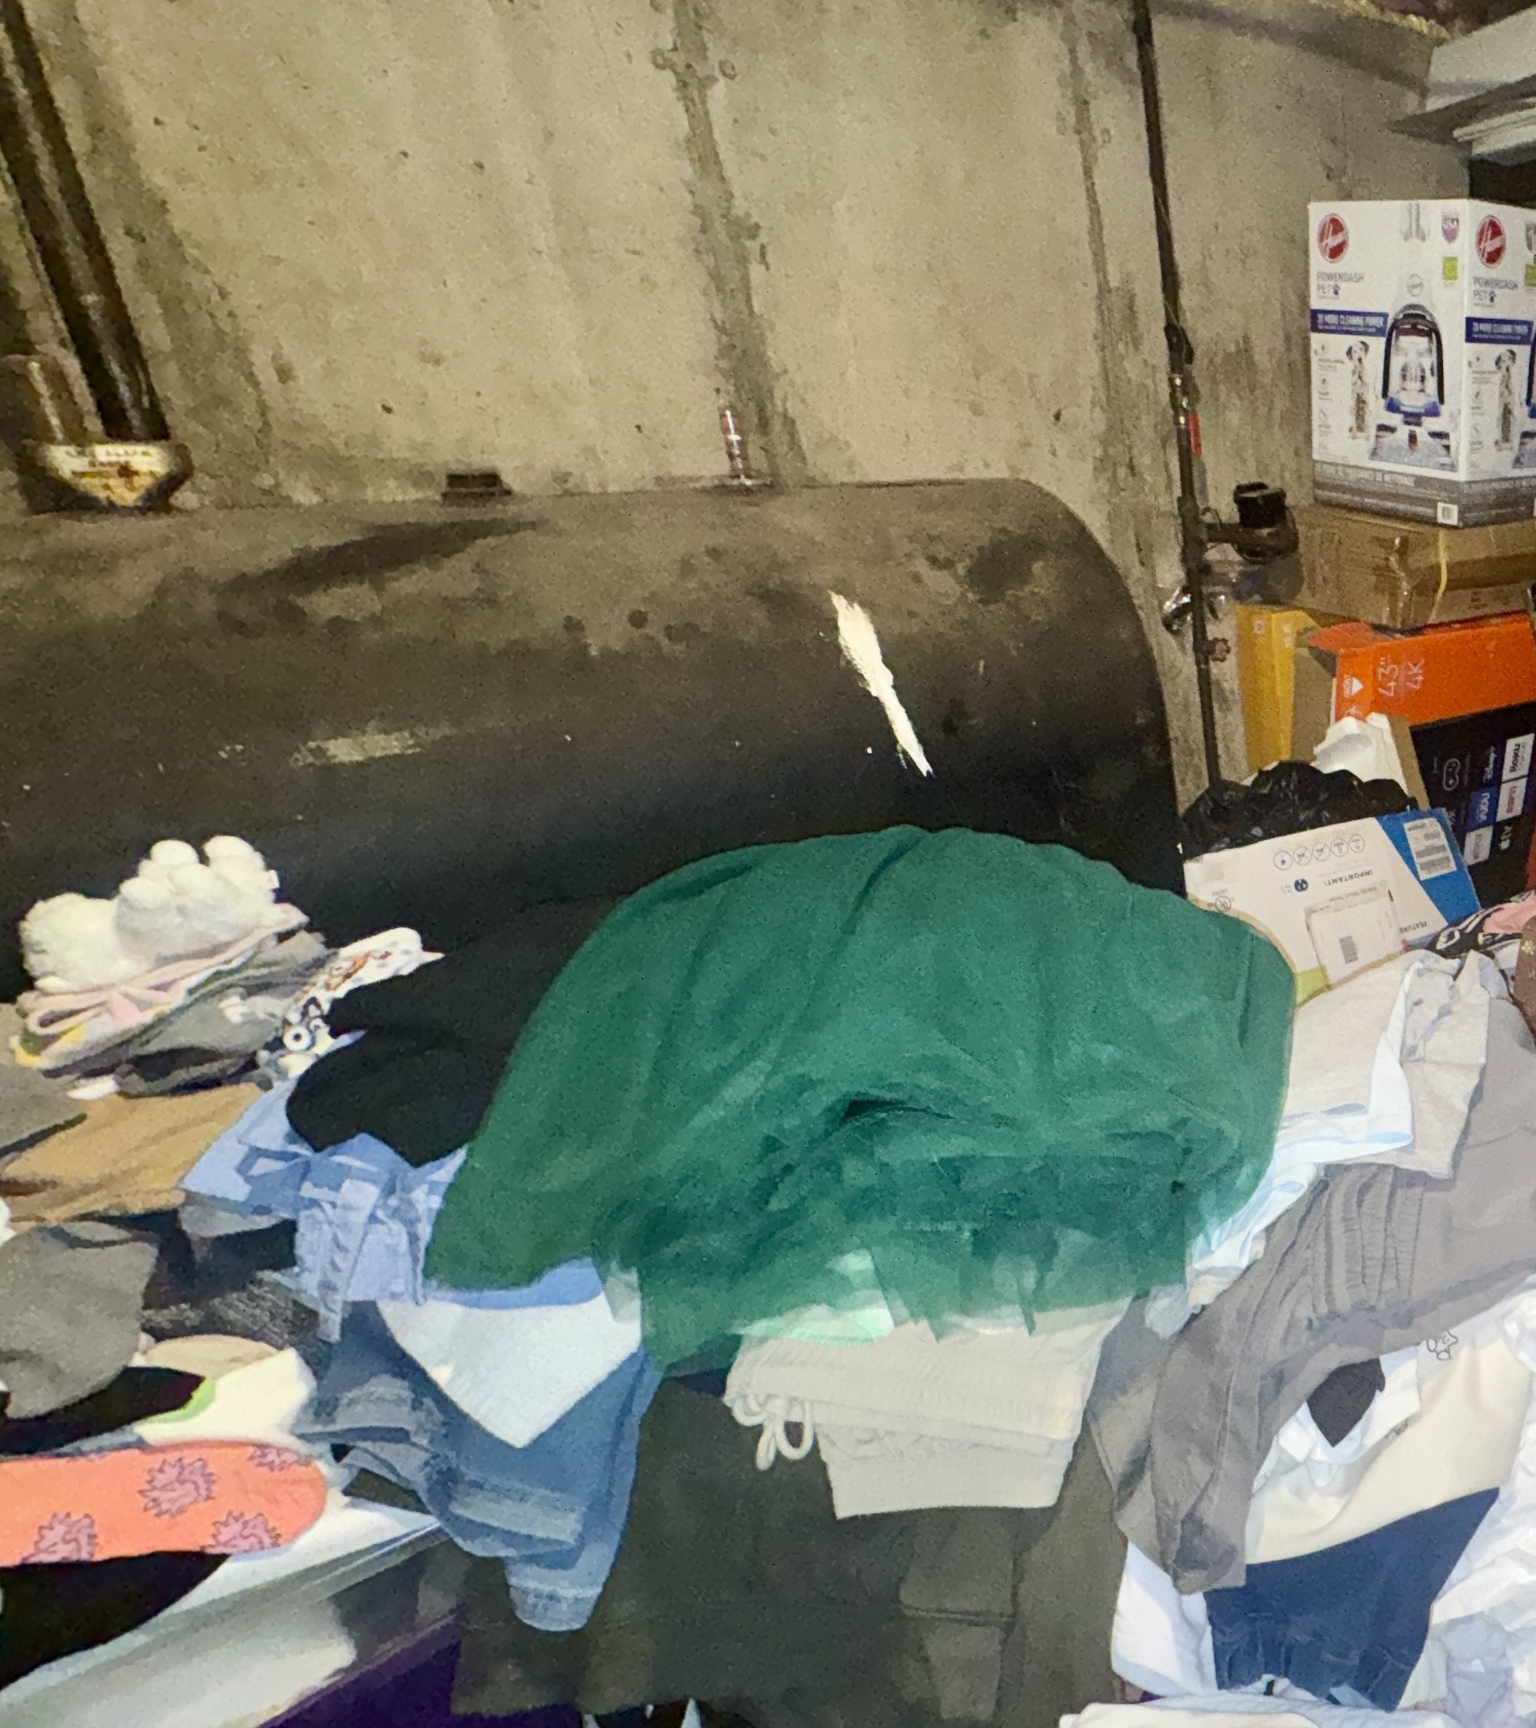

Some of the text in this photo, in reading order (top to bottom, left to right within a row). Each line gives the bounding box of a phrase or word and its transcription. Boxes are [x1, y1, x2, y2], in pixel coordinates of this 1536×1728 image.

[1316, 271, 1364, 283] POWERDASH
[1316, 284, 1331, 294] PET
[1473, 290, 1490, 301] PET
[1405, 658, 1426, 690] 4K
